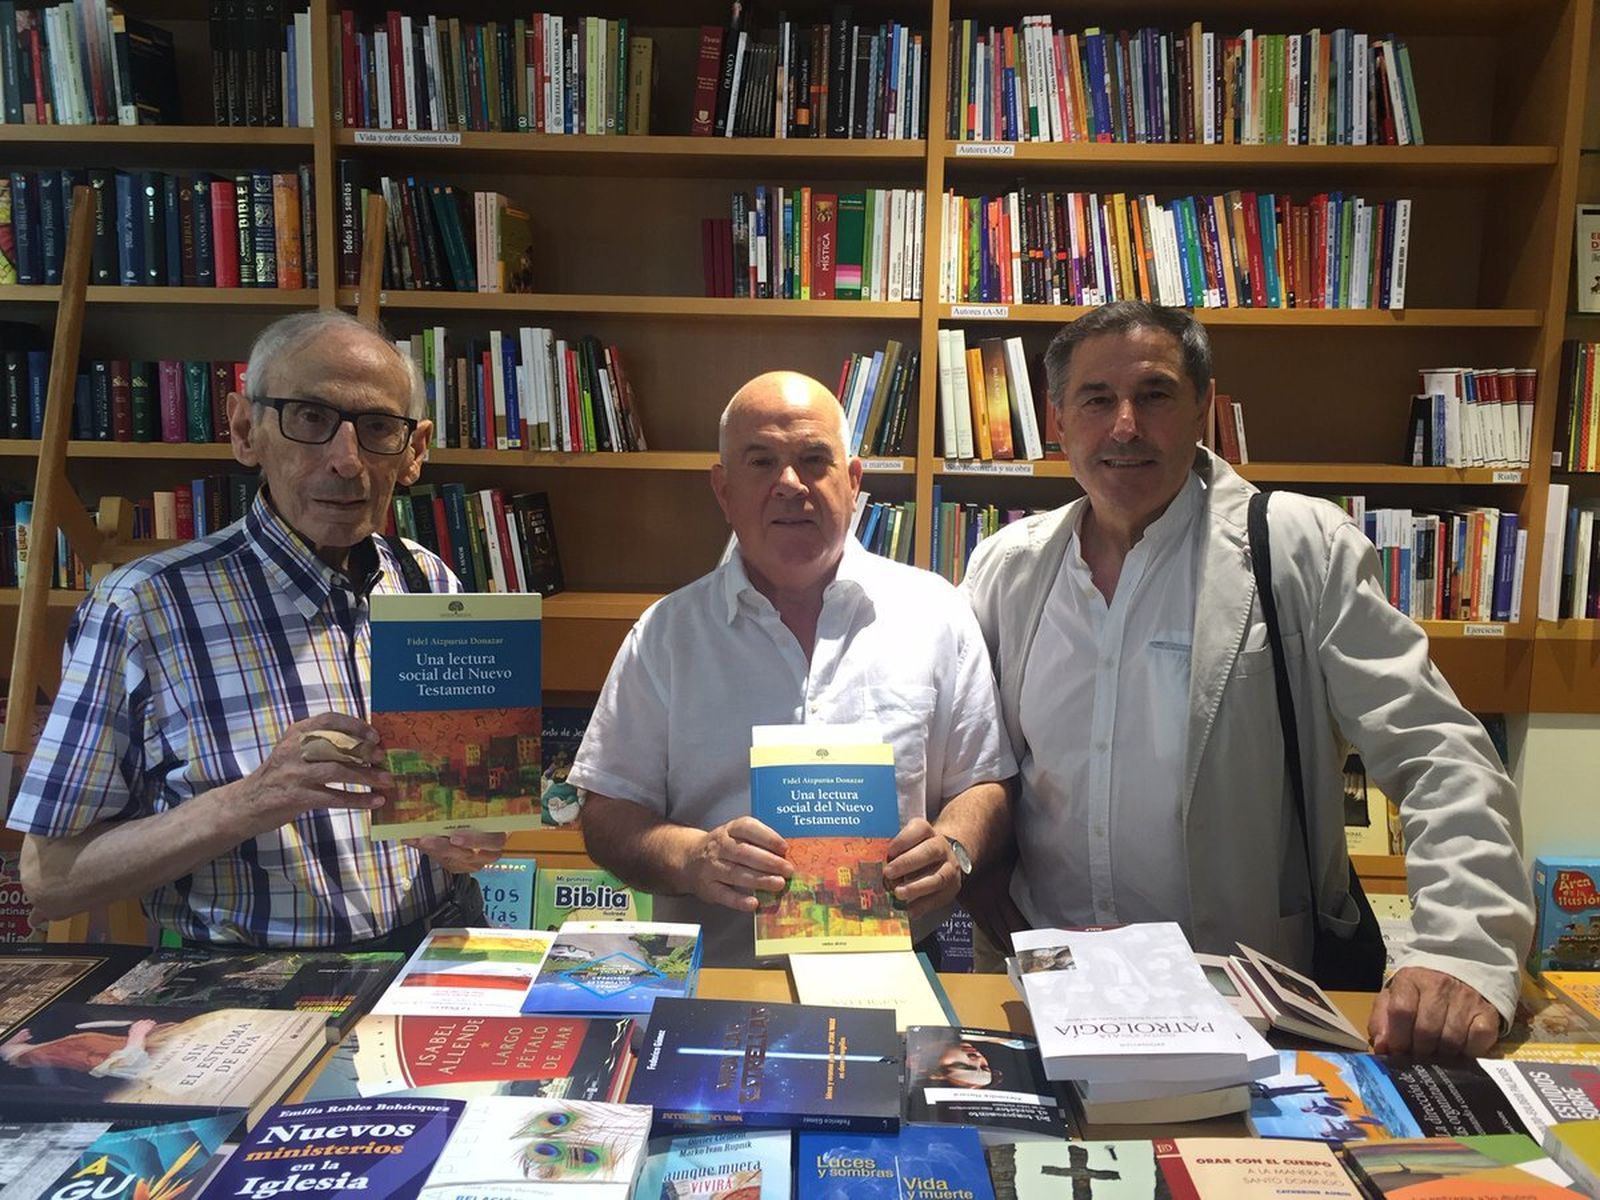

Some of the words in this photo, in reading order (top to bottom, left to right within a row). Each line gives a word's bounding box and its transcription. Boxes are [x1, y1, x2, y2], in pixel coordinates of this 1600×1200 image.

[359, 133, 377, 142] Vida
[385, 134, 401, 142] obra
[403, 133, 412, 142] de
[414, 133, 437, 143] Santos
[959, 146, 988, 154] Autores
[989, 146, 1012, 155] (M-Z)
[343, 182, 353, 211] santos
[17, 198, 27, 231] BIBLIA
[237, 186, 249, 228] BIBLE
[343, 213, 353, 228] los
[343, 229, 353, 255] Todos
[821, 233, 831, 271] MÍSTICA
[954, 308, 981, 316] Autores
[982, 308, 1006, 316] (A-M)
[1466, 626, 1502, 637] Ejercicios
[407, 637, 429, 646] Fidel
[470, 636, 504, 646] Donazar
[416, 653, 445, 666] Una
[448, 652, 496, 666] lectura
[399, 668, 438, 681] social
[442, 667, 464, 681] del
[468, 668, 512, 680] Nuevo
[416, 683, 496, 696] Testamento
[560, 727, 571, 737] de
[783, 777, 801, 785] Fidel
[836, 776, 864, 784] Donazar
[791, 790, 815, 800] Una
[818, 789, 859, 800] lectura
[776, 802, 811, 815] social
[814, 802, 832, 812] del
[836, 802, 874, 813] Nuevo
[792, 815, 861, 826] Testamento
[555, 886, 627, 908] Biblia
[937, 931, 970, 943] Historia
[1055, 1021, 1215, 1039] PATROLOGÍA
[182, 1043, 210, 1063] SIN
[215, 1058, 239, 1073] DE
[232, 1034, 261, 1055] EVA
[415, 1023, 457, 1067] ISABEL
[437, 1018, 484, 1075] ALLENDE
[492, 1027, 524, 1067] LARGO
[516, 1026, 549, 1069] PÉTALO
[541, 1051, 562, 1070] DE
[559, 1024, 575, 1048] MAR
[179, 1071, 205, 1087] EL
[197, 1023, 252, 1070] ESTIGMA
[646, 1041, 663, 1071] Federico
[1412, 1064, 1461, 1126] organizaciones
[1529, 1071, 1582, 1119] ESTUDIOS
[1561, 1086, 1600, 1120] SOBRE
[278, 1107, 323, 1118] Emilia
[328, 1103, 372, 1113] Robles
[375, 1102, 450, 1114] Bohórquez
[824, 1118, 851, 1127] Federico
[257, 1123, 416, 1145] Nuevos
[244, 1141, 405, 1162] ministerios
[679, 1148, 705, 1158] Marko
[705, 1145, 724, 1156] Ivan
[725, 1141, 753, 1155] Rupnik
[72, 1155, 109, 1179] A
[290, 1162, 318, 1172] en
[321, 1160, 340, 1171] la
[816, 1154, 876, 1170] Luces
[1283, 1159, 1332, 1168] CUERPO
[662, 1166, 714, 1183] aunque
[718, 1161, 763, 1175] muera
[817, 1169, 826, 1179] y
[829, 1166, 894, 1179] sombras
[1323, 1169, 1339, 1177] DE
[234, 1172, 369, 1200] Iglesia
[689, 1176, 734, 1193] VIVIRÁ
[903, 1177, 950, 1191] Vida
[1284, 1177, 1345, 1187] DOMINGO
[907, 1190, 917, 1200] y
[919, 1190, 974, 1200] muerte
